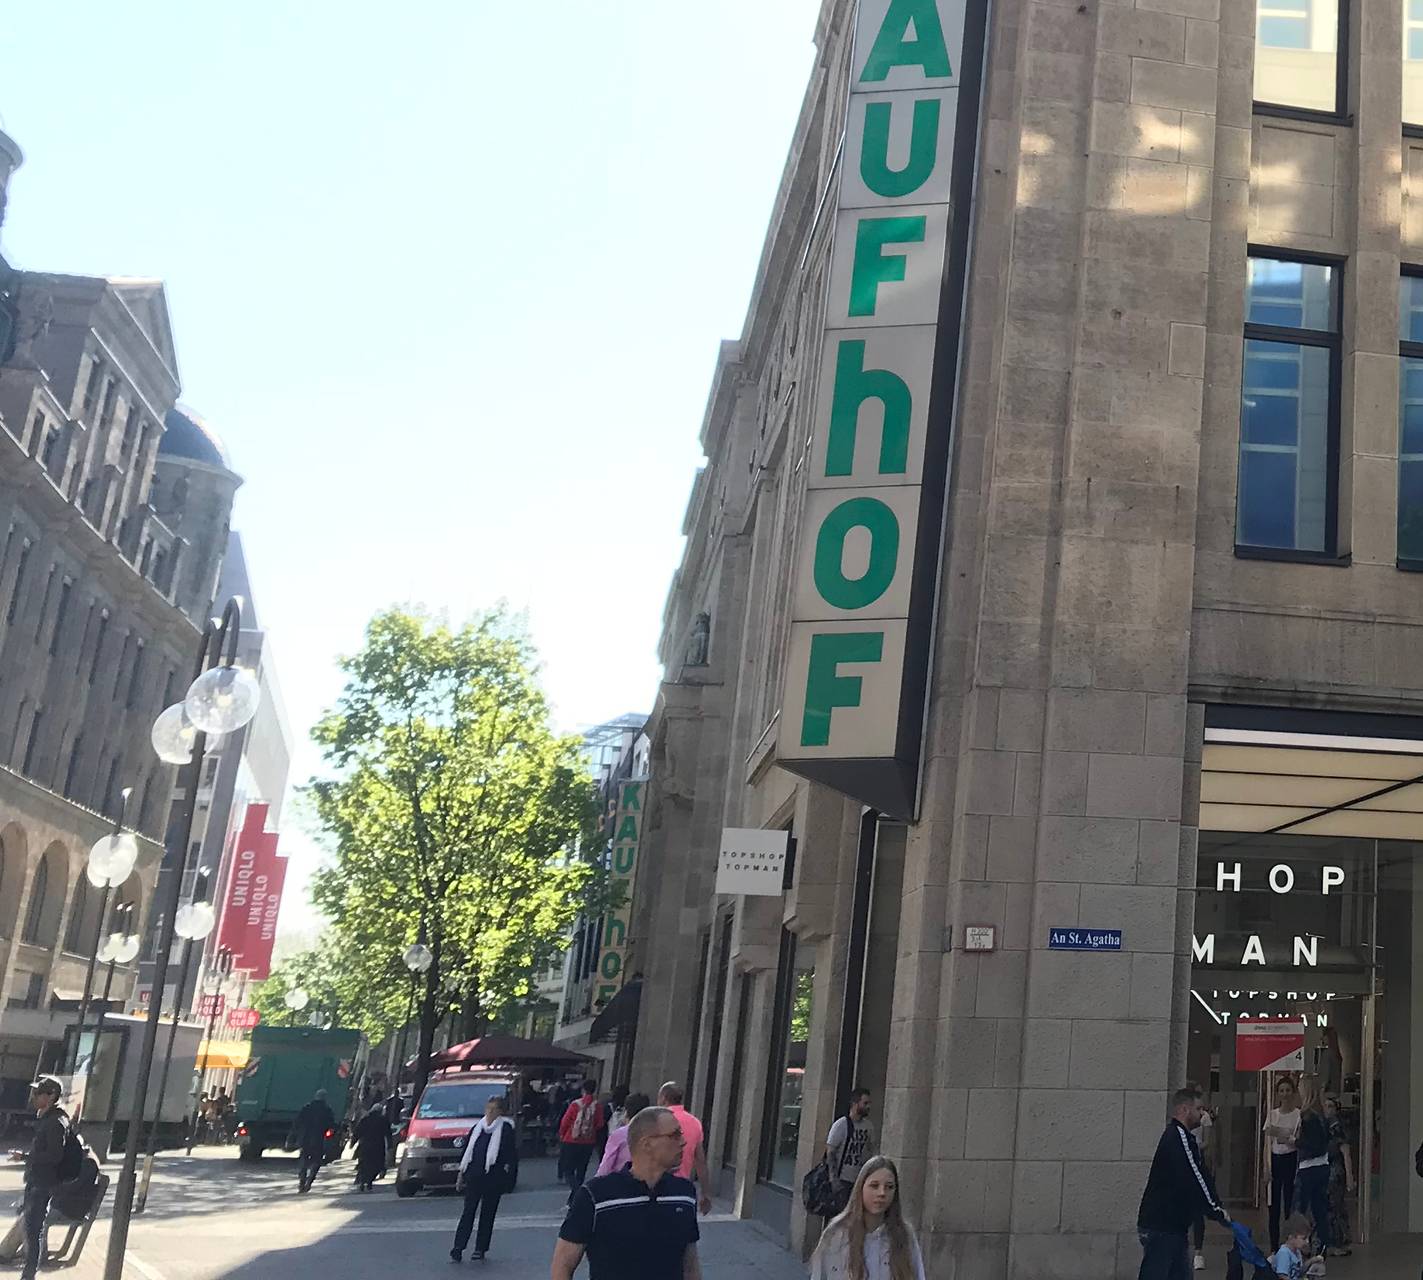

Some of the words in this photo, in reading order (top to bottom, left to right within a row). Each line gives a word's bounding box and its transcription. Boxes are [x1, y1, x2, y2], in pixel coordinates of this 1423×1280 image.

[722, 851, 785, 860] TOPSHOP
[726, 863, 779, 872] TOPMAN
[232, 850, 256, 907] UNIQLO
[1216, 861, 1345, 895] HOP
[247, 874, 269, 926] UNIQLO
[260, 893, 280, 941] UNIQLO
[1050, 932, 1066, 944] An
[1068, 931, 1082, 944] St.
[1084, 932, 1120, 948] Agatha
[1190, 933, 1318, 966] MAN
[1295, 1051, 1302, 1061] 4
